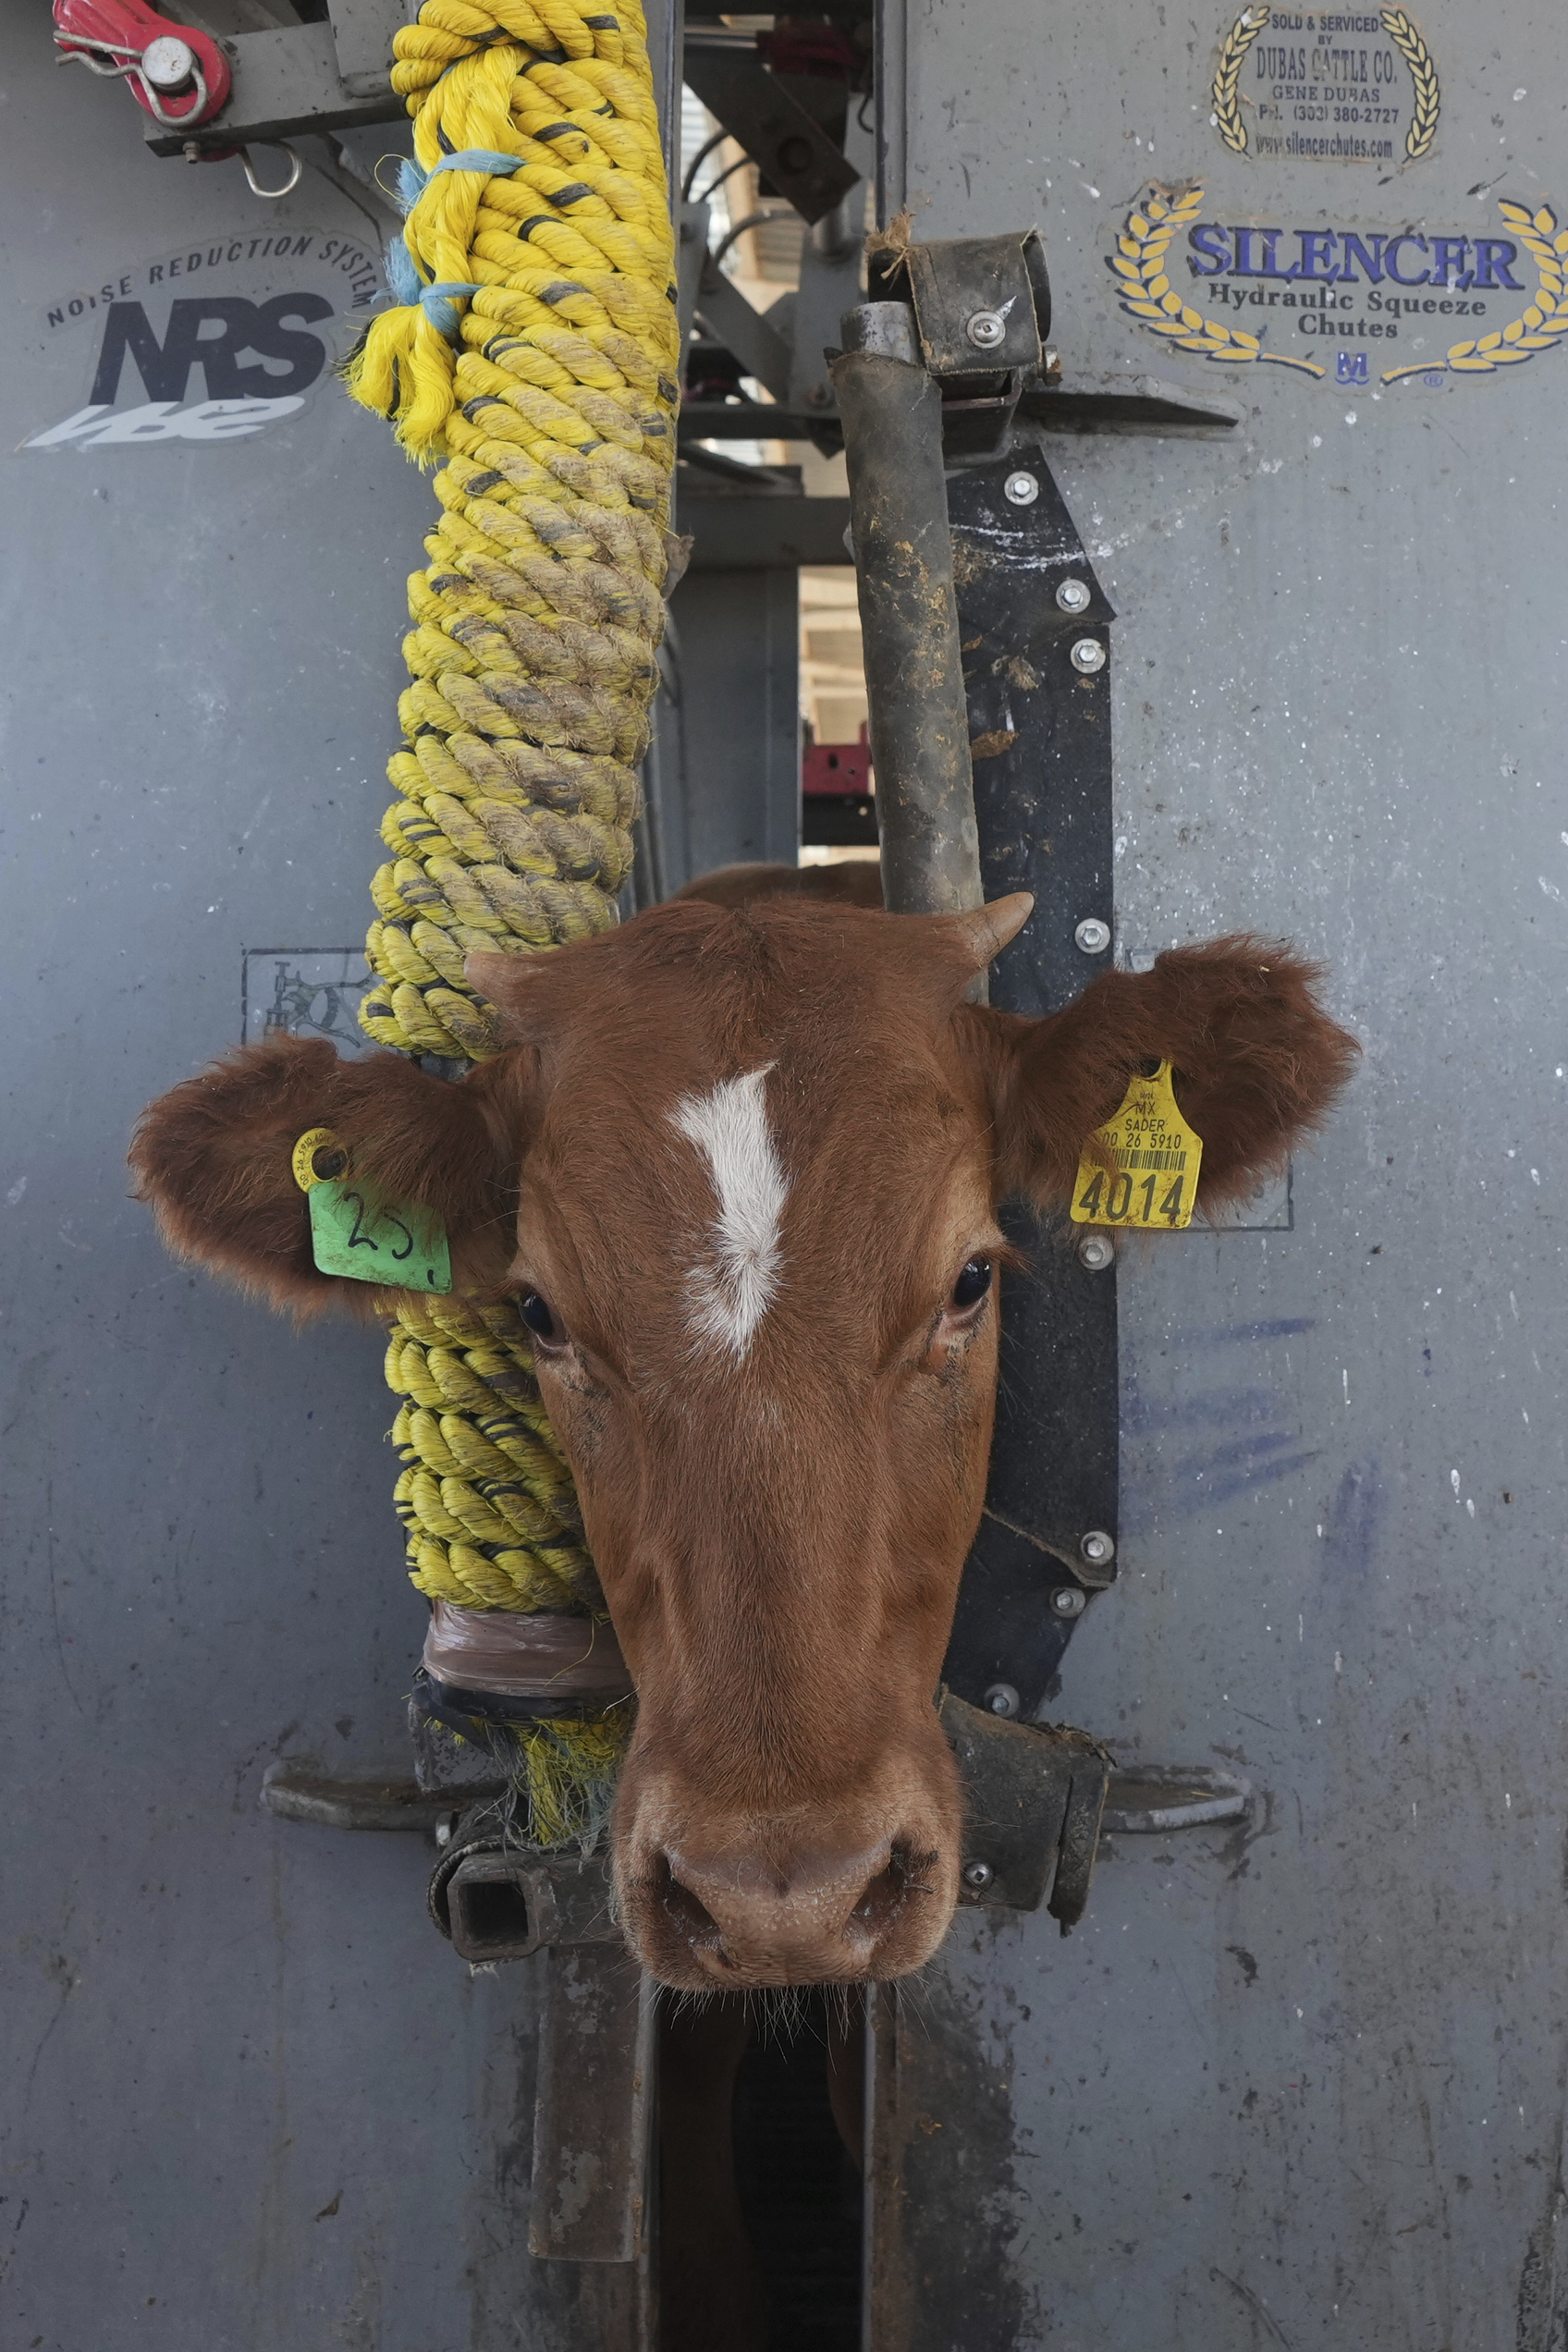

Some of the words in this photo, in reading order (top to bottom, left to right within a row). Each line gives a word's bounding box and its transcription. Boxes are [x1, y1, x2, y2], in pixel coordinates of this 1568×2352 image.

[1272, 14, 1303, 31] SOLD
[1307, 16, 1316, 31] &
[1320, 16, 1378, 32] SERVICED
[1318, 35, 1333, 45] BY
[1256, 47, 1306, 80] DUBAS
[1312, 48, 1368, 83] CATTLE
[1374, 50, 1398, 84] CO.
[1273, 85, 1318, 101] GENE
[1324, 87, 1380, 103] DUBAS
[1333, 106, 1399, 123] 380-2727
[1256, 130, 1393, 158] wwwsilencerchutes.com
[1186, 222, 1525, 292] SILENCER
[46, 276, 132, 328] NOISE
[149, 235, 313, 286] REDUCTION
[318, 239, 378, 309] SYSTEM
[1208, 282, 1354, 311] Hydraulic
[1366, 290, 1487, 318] Squeeze
[1297, 312, 1399, 338] Chutes
[88, 291, 336, 407] NRS
[1135, 1100, 1156, 1115] MX
[1125, 1118, 1166, 1133] SADER
[1103, 1132, 1119, 1146] 00
[1126, 1133, 1141, 1148] 26
[1150, 1133, 1182, 1149] 5910
[1079, 1170, 1184, 1227] 4014
